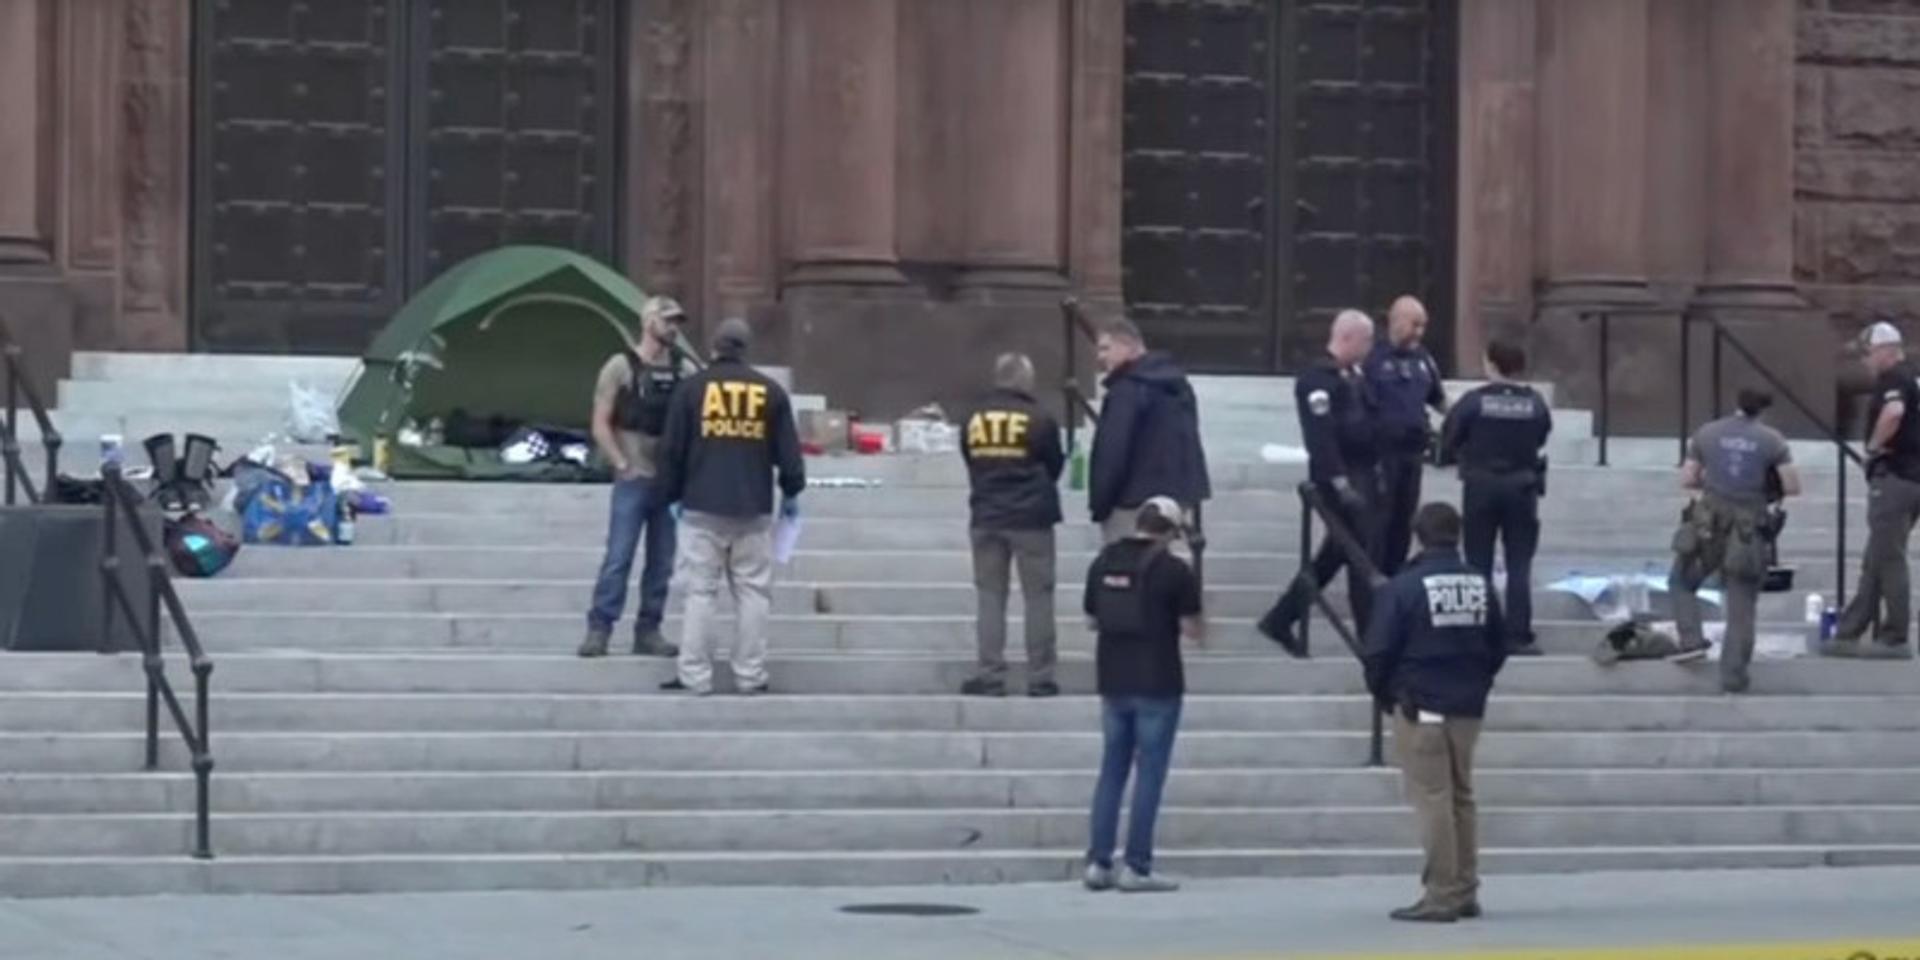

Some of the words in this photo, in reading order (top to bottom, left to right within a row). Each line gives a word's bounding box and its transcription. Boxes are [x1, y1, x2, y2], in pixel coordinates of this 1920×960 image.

[702, 382, 767, 418] ATF
[702, 419, 765, 438] POLICE
[967, 411, 1029, 444] ATF
[1428, 587, 1487, 613] POLICE
